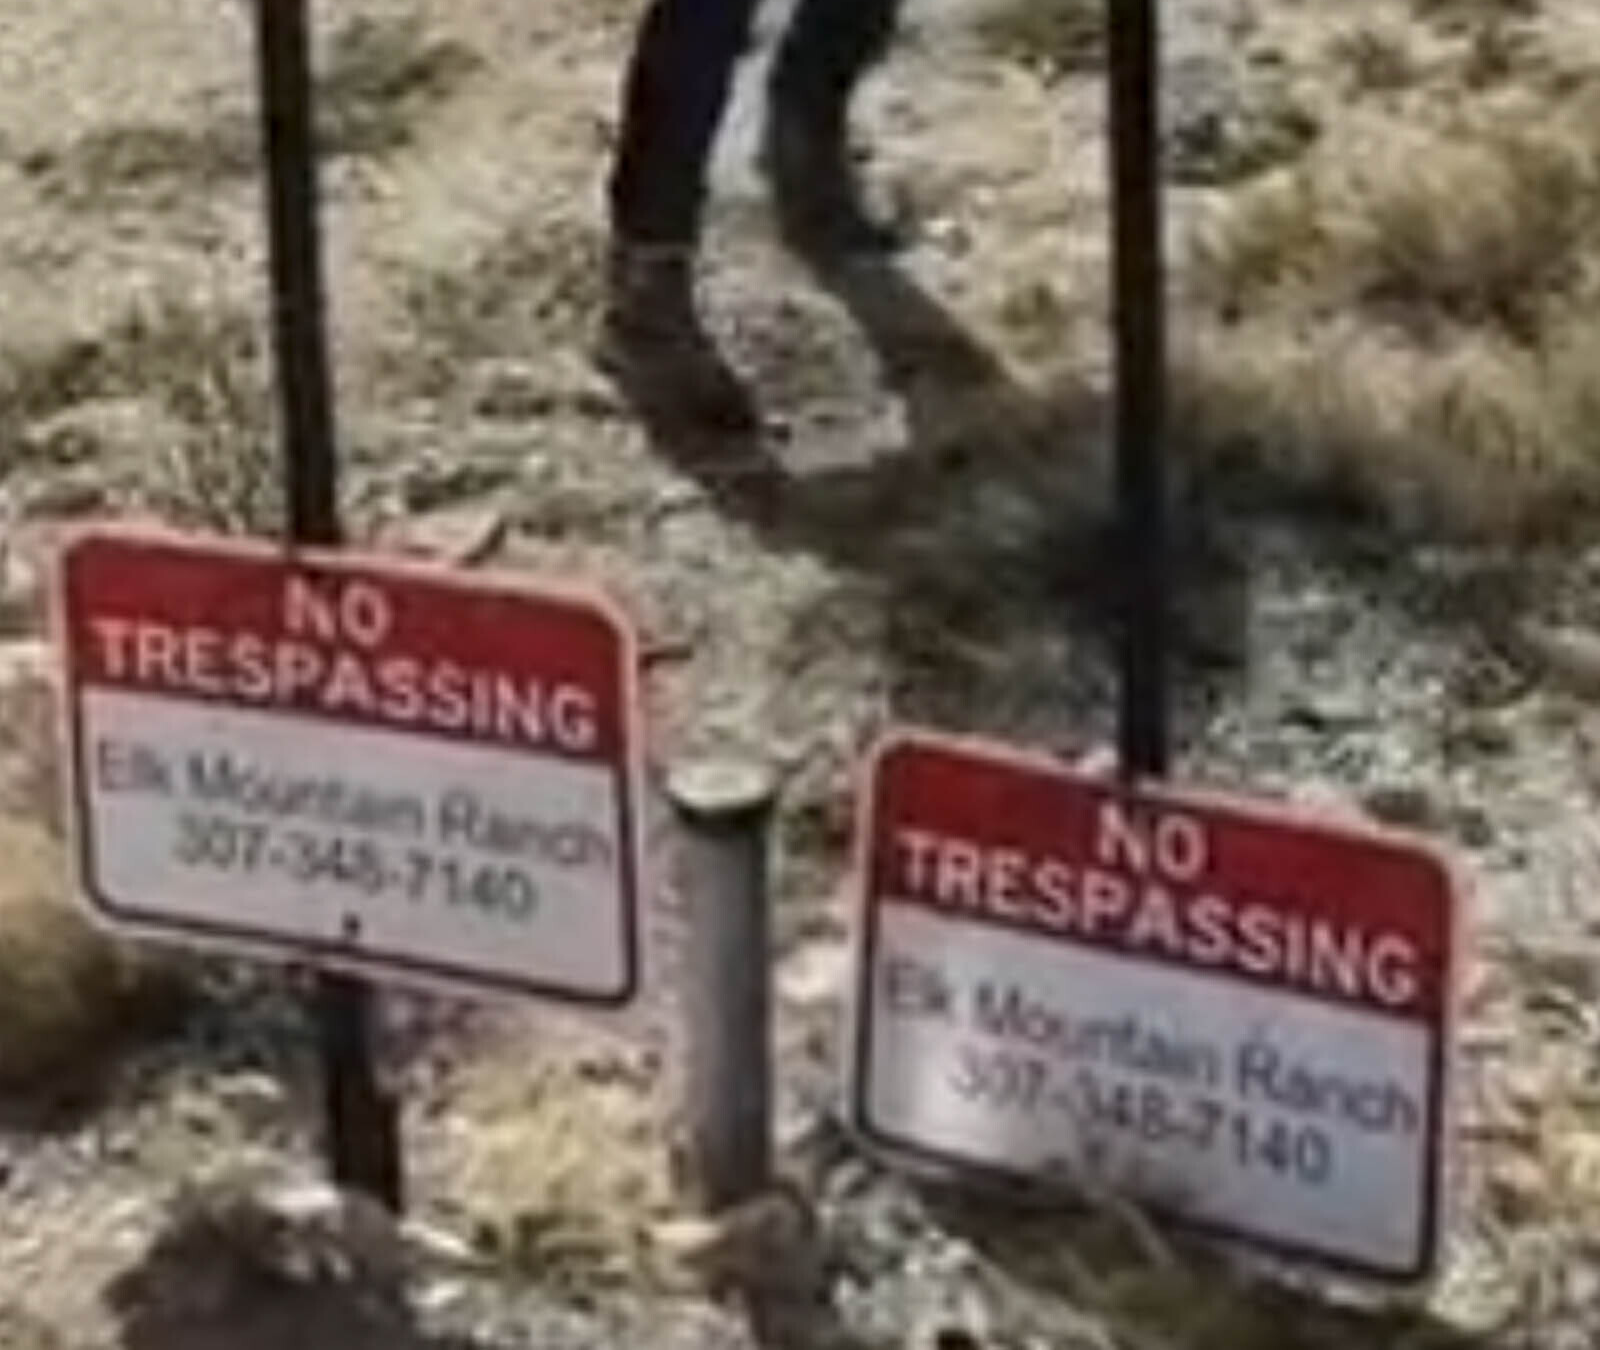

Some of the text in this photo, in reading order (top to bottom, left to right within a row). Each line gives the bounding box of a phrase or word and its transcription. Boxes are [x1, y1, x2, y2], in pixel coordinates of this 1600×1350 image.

[284, 577, 391, 647] NO
[90, 618, 596, 749] TRESPASSING
[98, 740, 614, 868] Elk Mountain Ranch
[1099, 803, 1207, 875] NO
[899, 830, 1415, 1004] TRESPASSING
[977, 983, 1219, 1083] Mountain
[1238, 1037, 1419, 1134] Ranch
